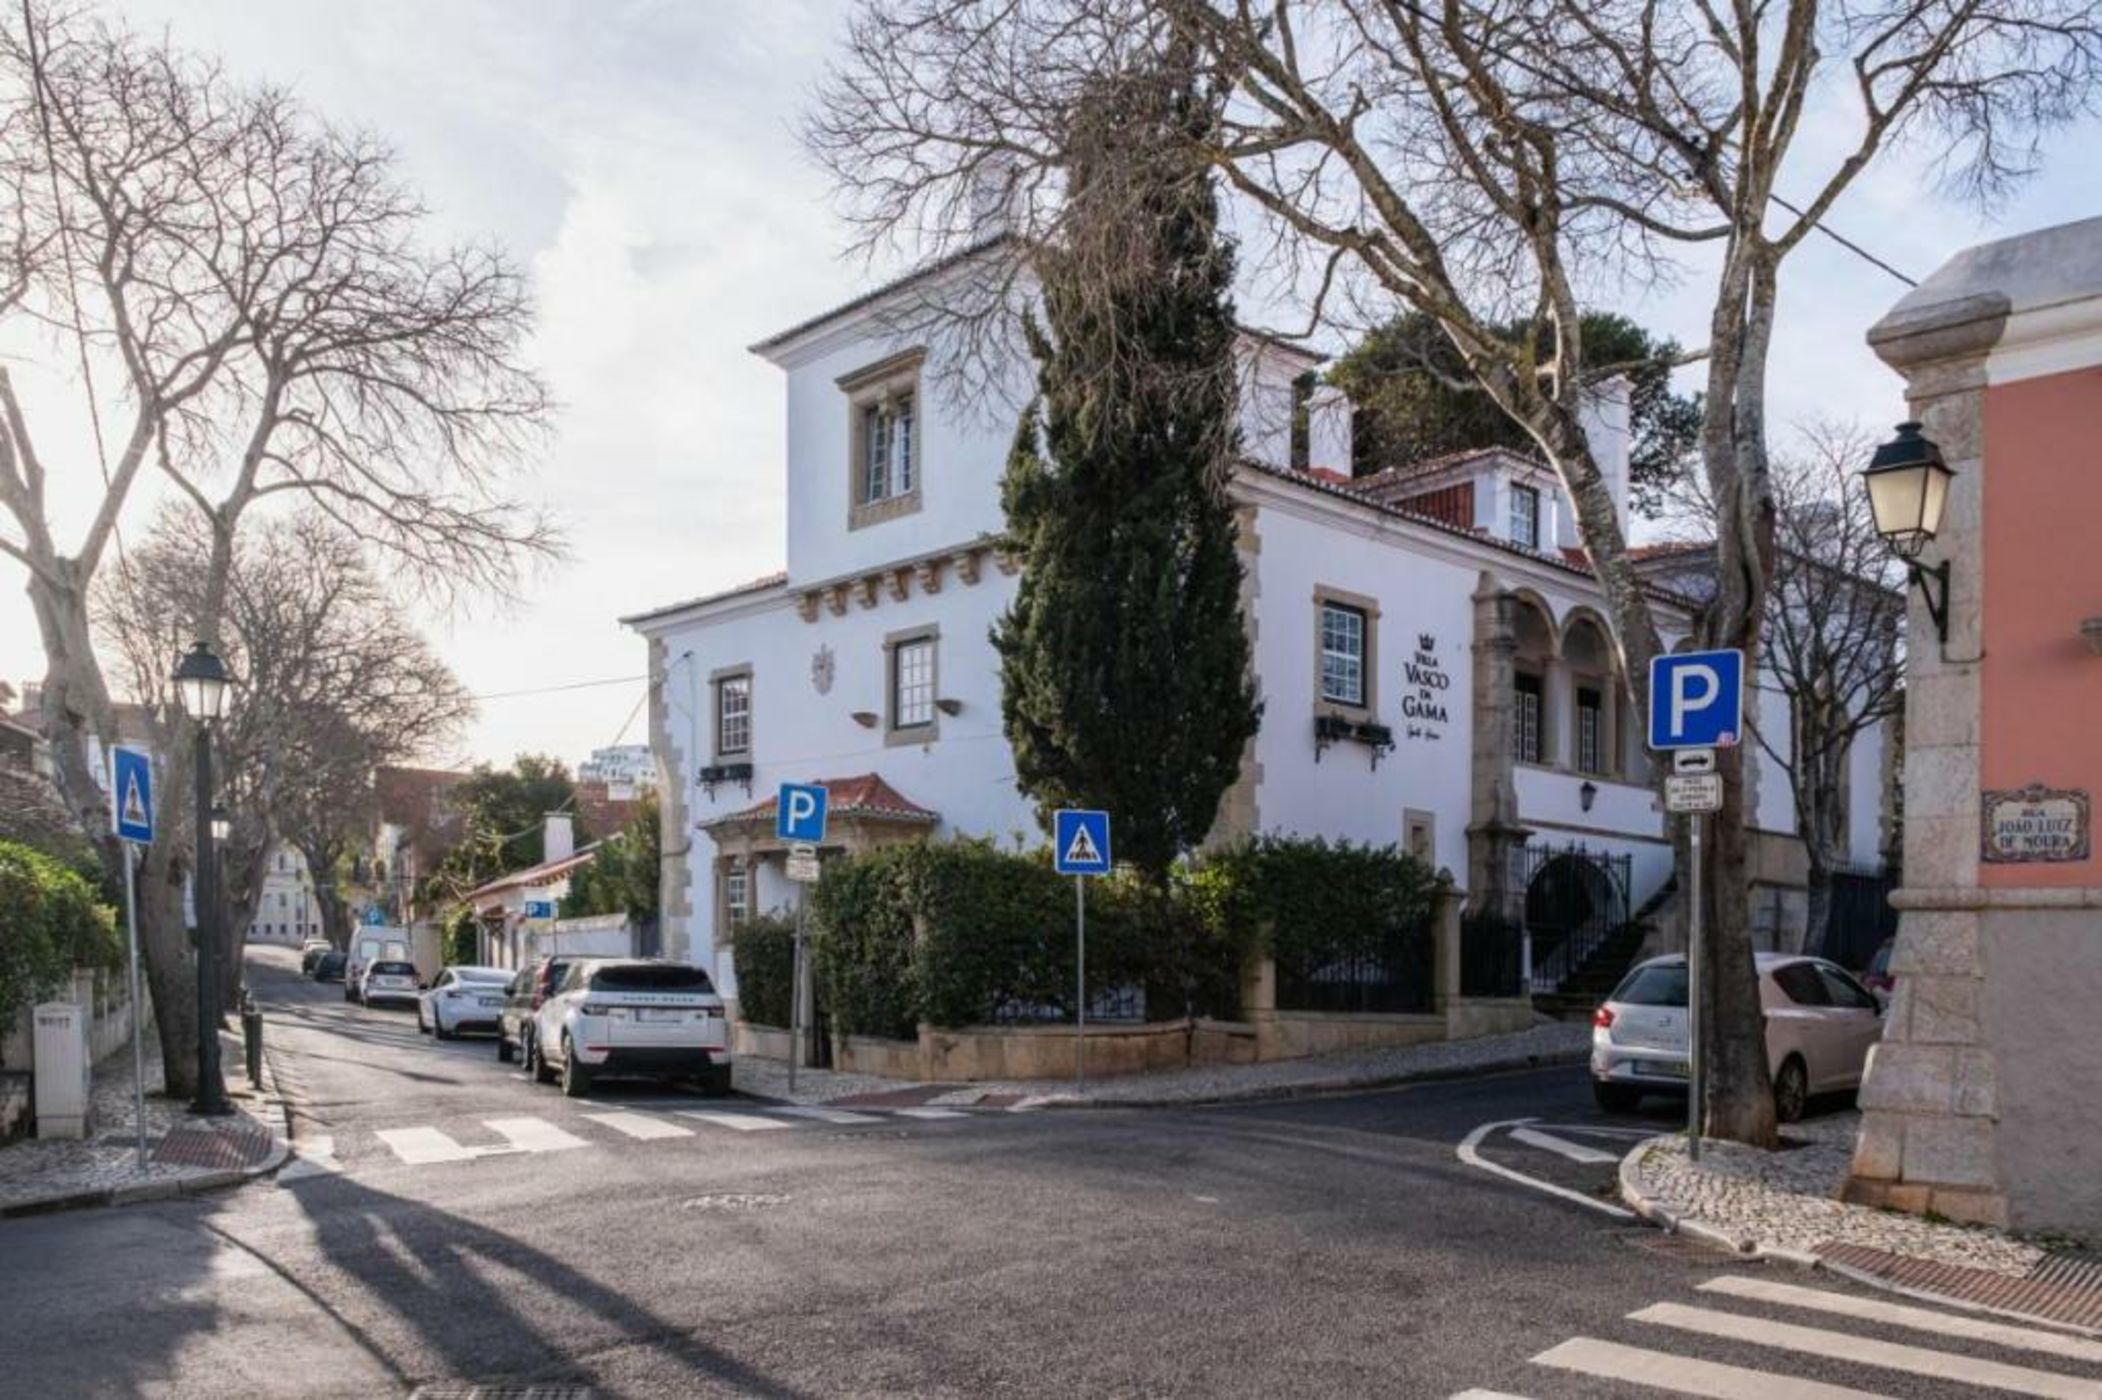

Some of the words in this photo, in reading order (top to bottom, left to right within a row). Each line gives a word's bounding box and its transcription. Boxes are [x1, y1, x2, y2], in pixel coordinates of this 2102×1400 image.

[1414, 651, 1439, 667] VILLA
[1403, 662, 1450, 690] VASCO
[1402, 695, 1448, 723] GAMA
[1670, 664, 1720, 738] P
[787, 789, 816, 834] P
[2038, 818, 2072, 834] LUIZ
